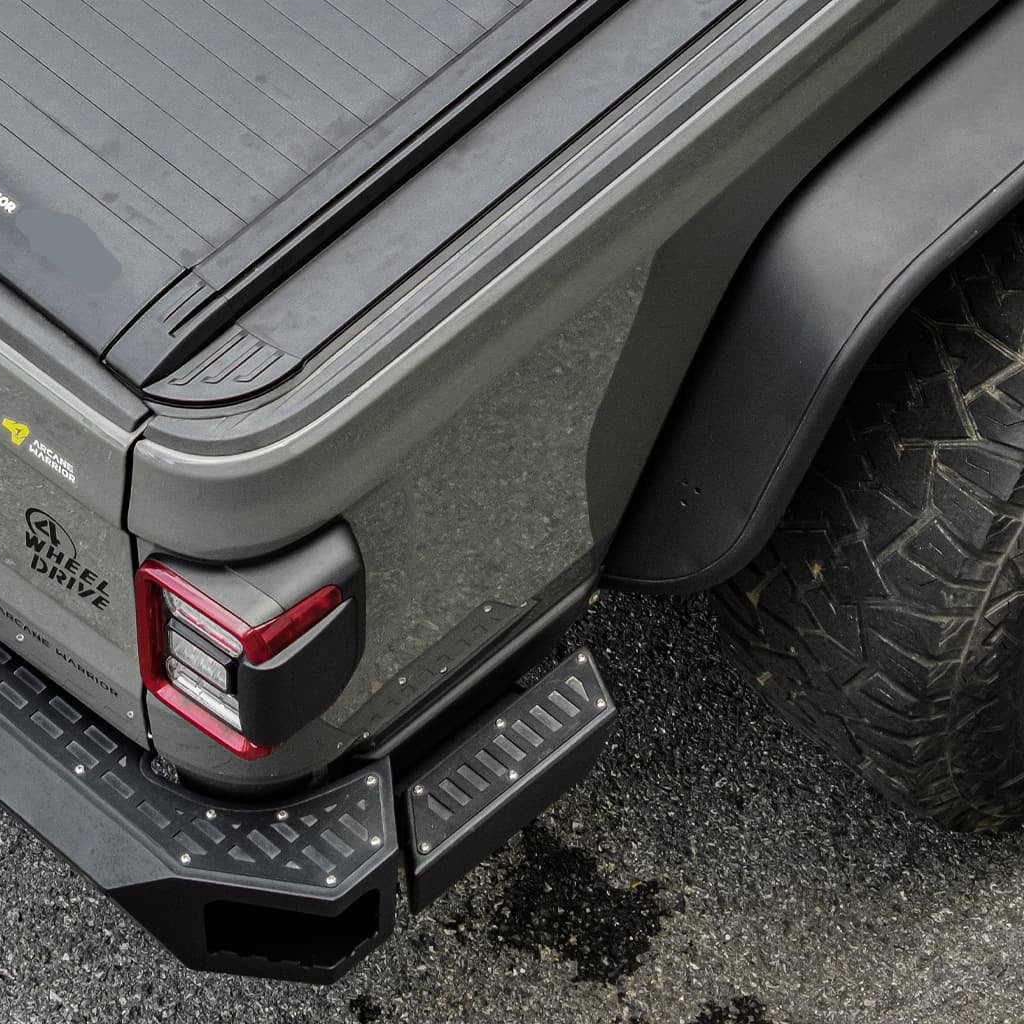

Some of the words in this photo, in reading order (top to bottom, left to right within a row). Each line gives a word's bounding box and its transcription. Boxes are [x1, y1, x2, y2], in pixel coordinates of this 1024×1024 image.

[29, 444, 76, 484] WARRIOR
[32, 439, 74, 473] ARCANE
[33, 518, 62, 547] 4
[24, 530, 111, 597] WHEEL
[30, 553, 111, 611] DRIVE
[55, 647, 119, 697] WARRIOR
